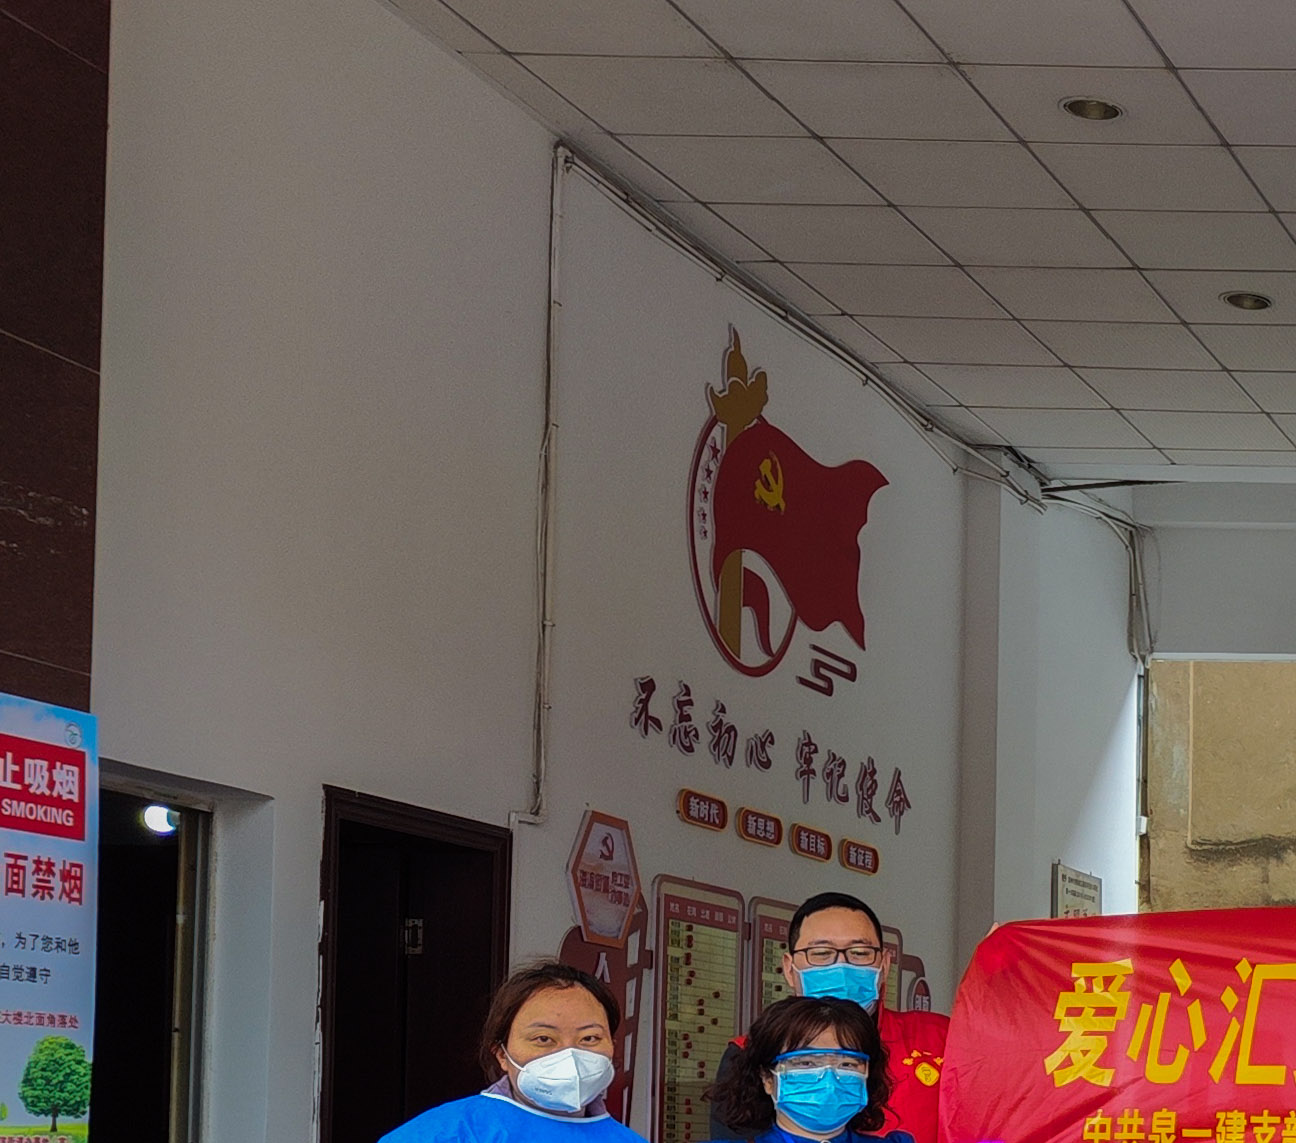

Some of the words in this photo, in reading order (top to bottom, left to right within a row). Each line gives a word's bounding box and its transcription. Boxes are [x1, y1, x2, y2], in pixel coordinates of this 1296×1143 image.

[630, 676, 775, 769] 不忘初心
[796, 730, 911, 834] 牢记使命
[1, 798, 74, 826] SMOKING
[689, 796, 720, 824] 新时代
[747, 815, 775, 840] 新思想
[799, 831, 826, 855] 新目标
[849, 846, 873, 869] 新征程
[4, 852, 84, 906] 面禁烟
[0, 1010, 79, 1030] 大楼北面角落处
